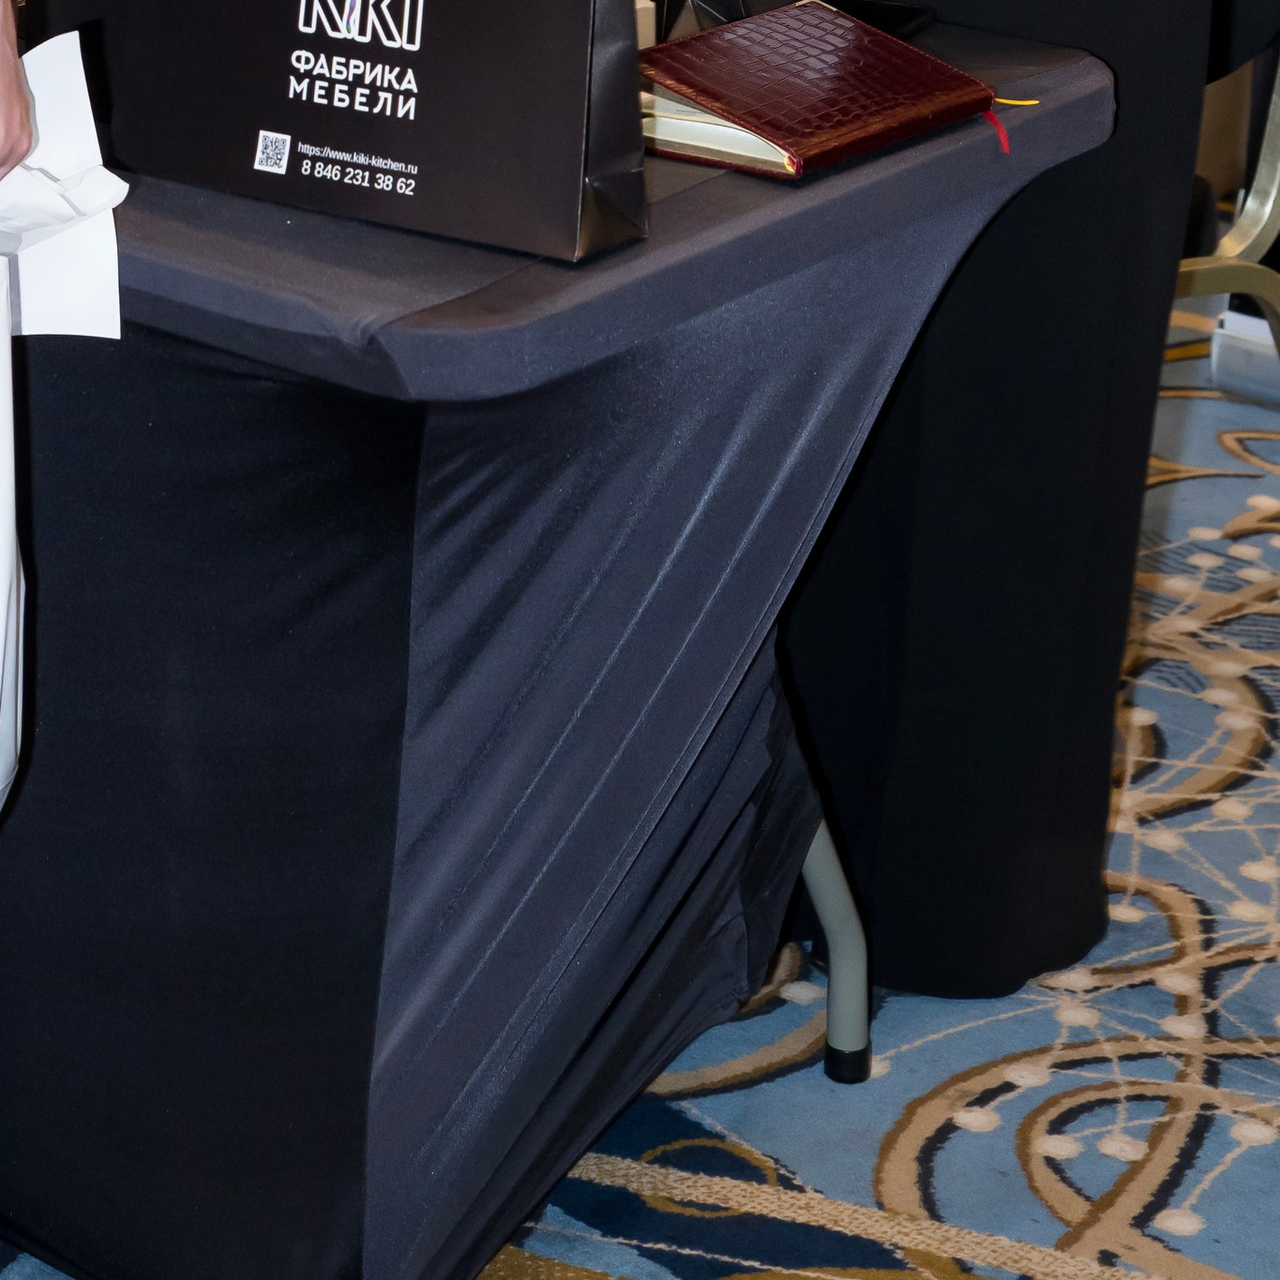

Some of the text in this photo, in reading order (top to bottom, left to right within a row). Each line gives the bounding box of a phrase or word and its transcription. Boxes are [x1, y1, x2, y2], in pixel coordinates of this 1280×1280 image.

[290, 48, 418, 93] ФАБРИКА
[288, 76, 416, 121] МЕБЕЛИ
[297, 140, 418, 175] https://www.kiki-kitchen.ru
[301, 159, 415, 196] 8 846 231 38 62
